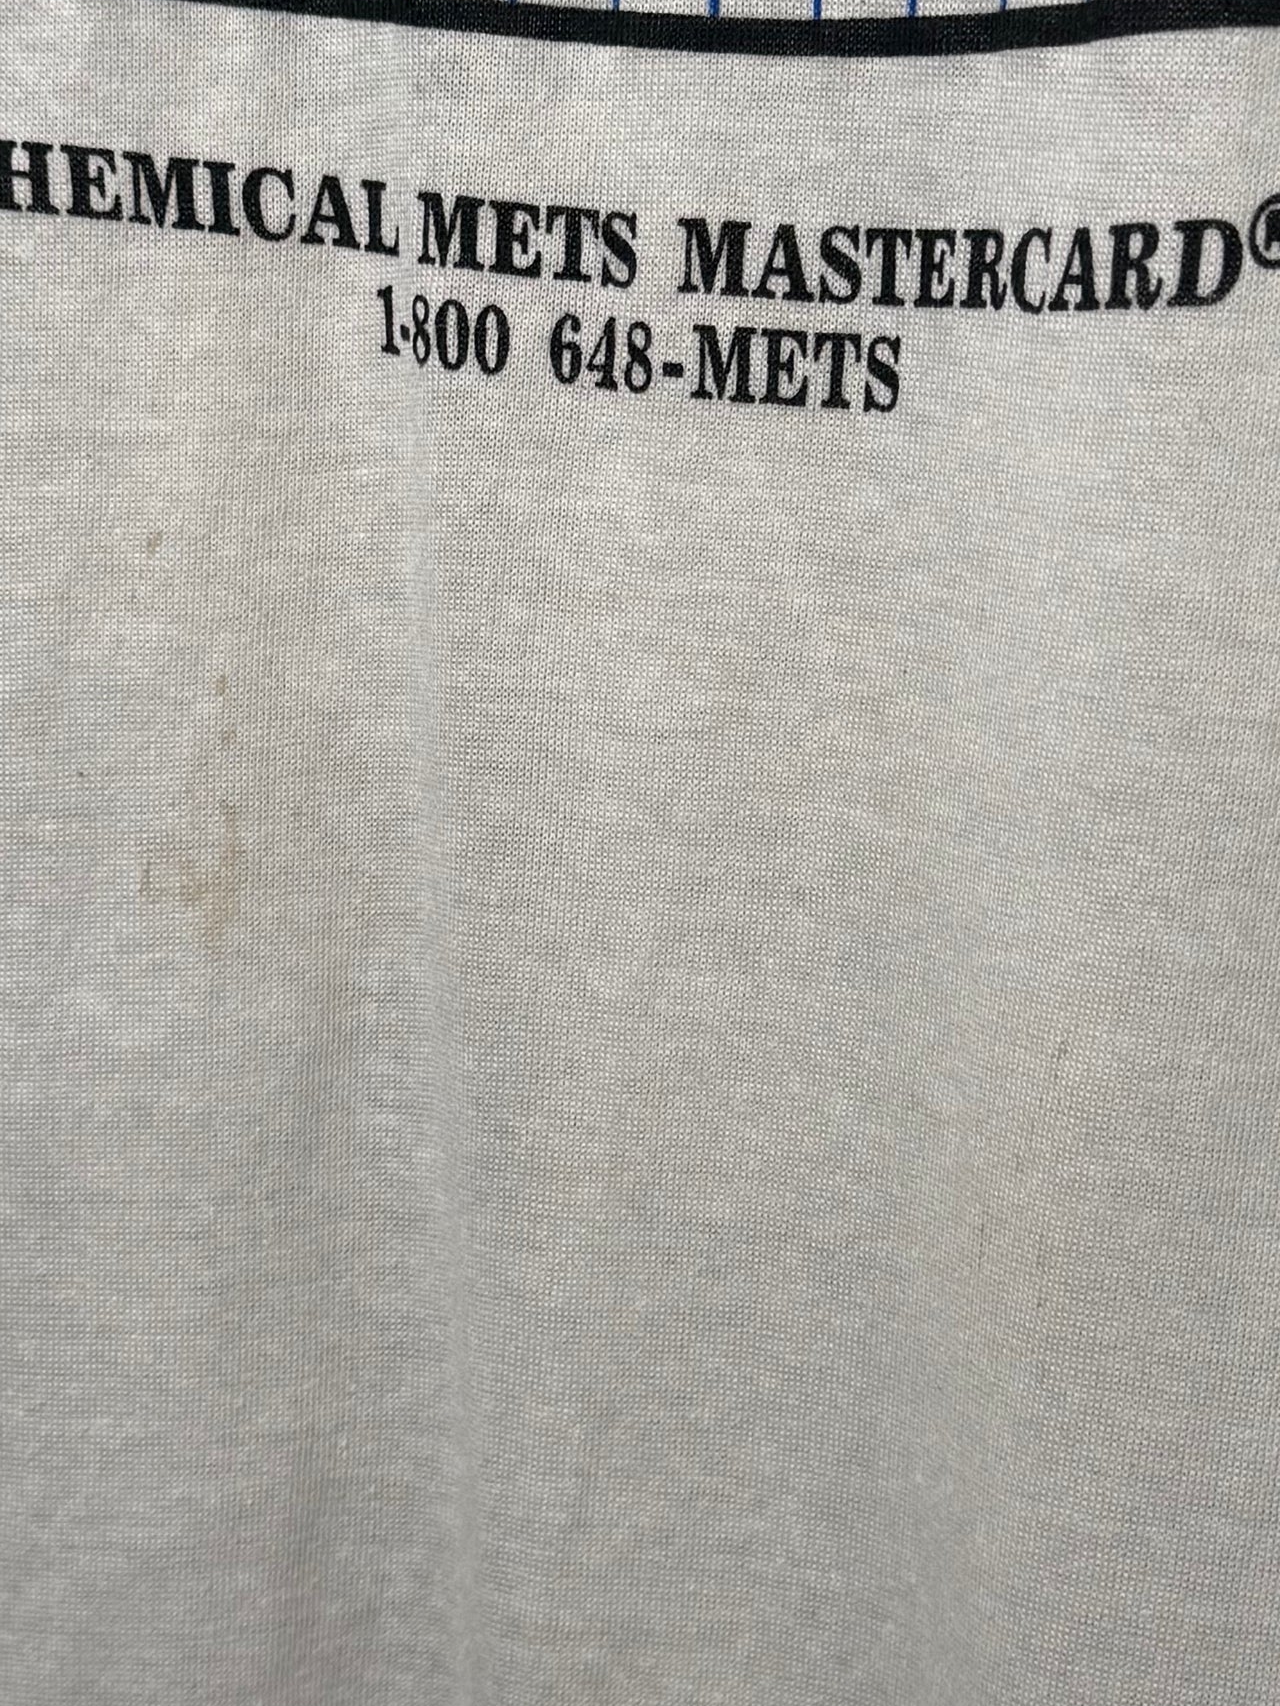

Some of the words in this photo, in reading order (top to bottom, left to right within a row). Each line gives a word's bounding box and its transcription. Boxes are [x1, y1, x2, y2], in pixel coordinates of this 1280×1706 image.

[417, 192, 639, 290] METS
[375, 285, 511, 377] 1-800
[549, 312, 902, 413] 648-METS
